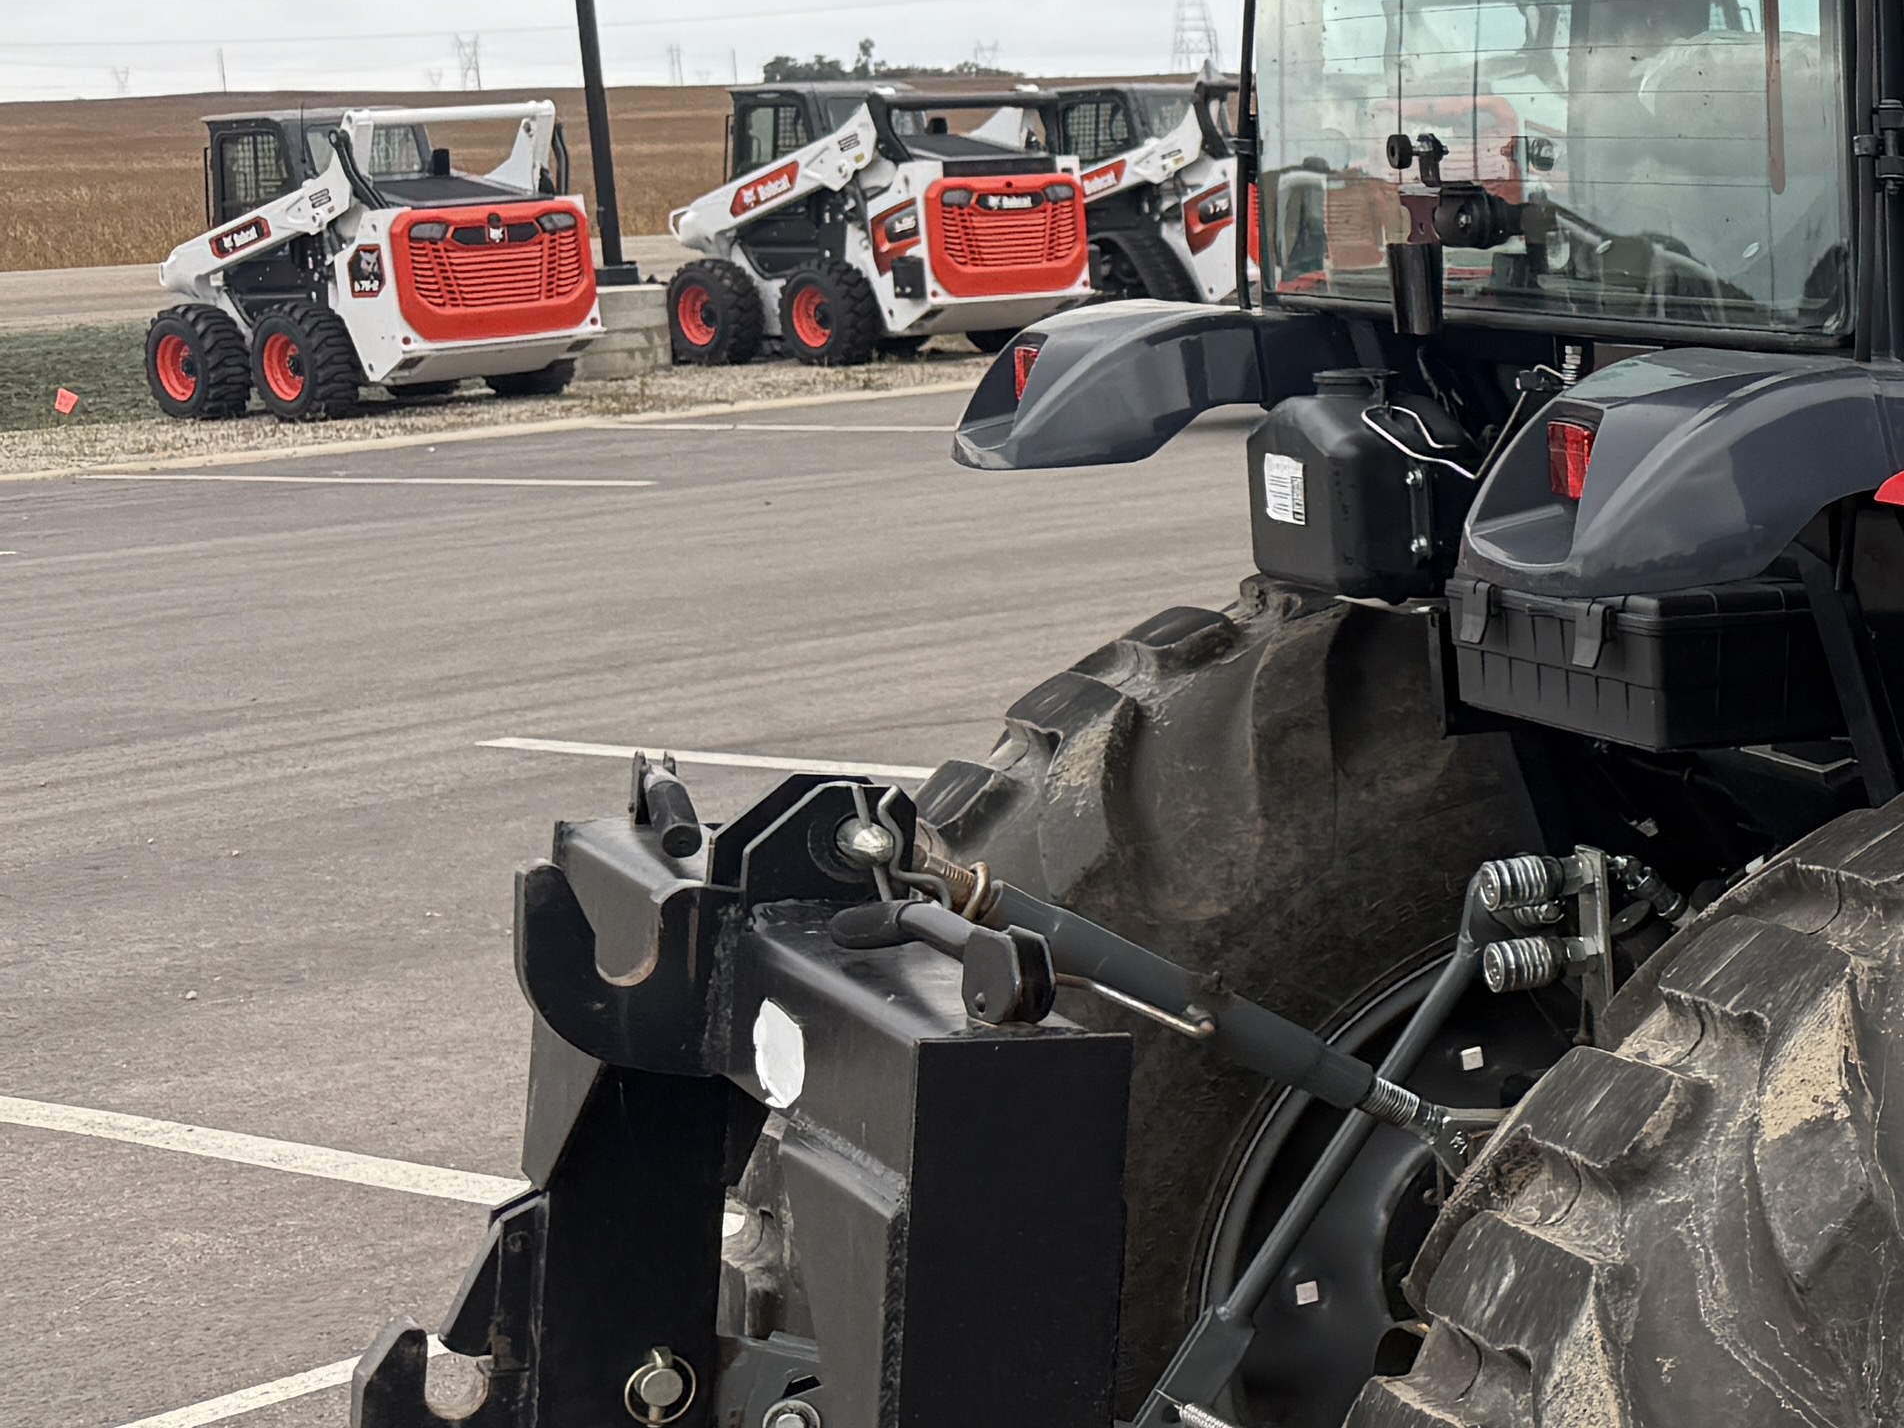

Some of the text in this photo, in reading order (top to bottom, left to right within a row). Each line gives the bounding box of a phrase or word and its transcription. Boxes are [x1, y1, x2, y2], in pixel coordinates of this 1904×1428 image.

[757, 173, 790, 201] Bobcat
[1083, 169, 1118, 196] Bobcat
[1002, 195, 1032, 209] Bobcat
[233, 226, 258, 248] Bobcat
